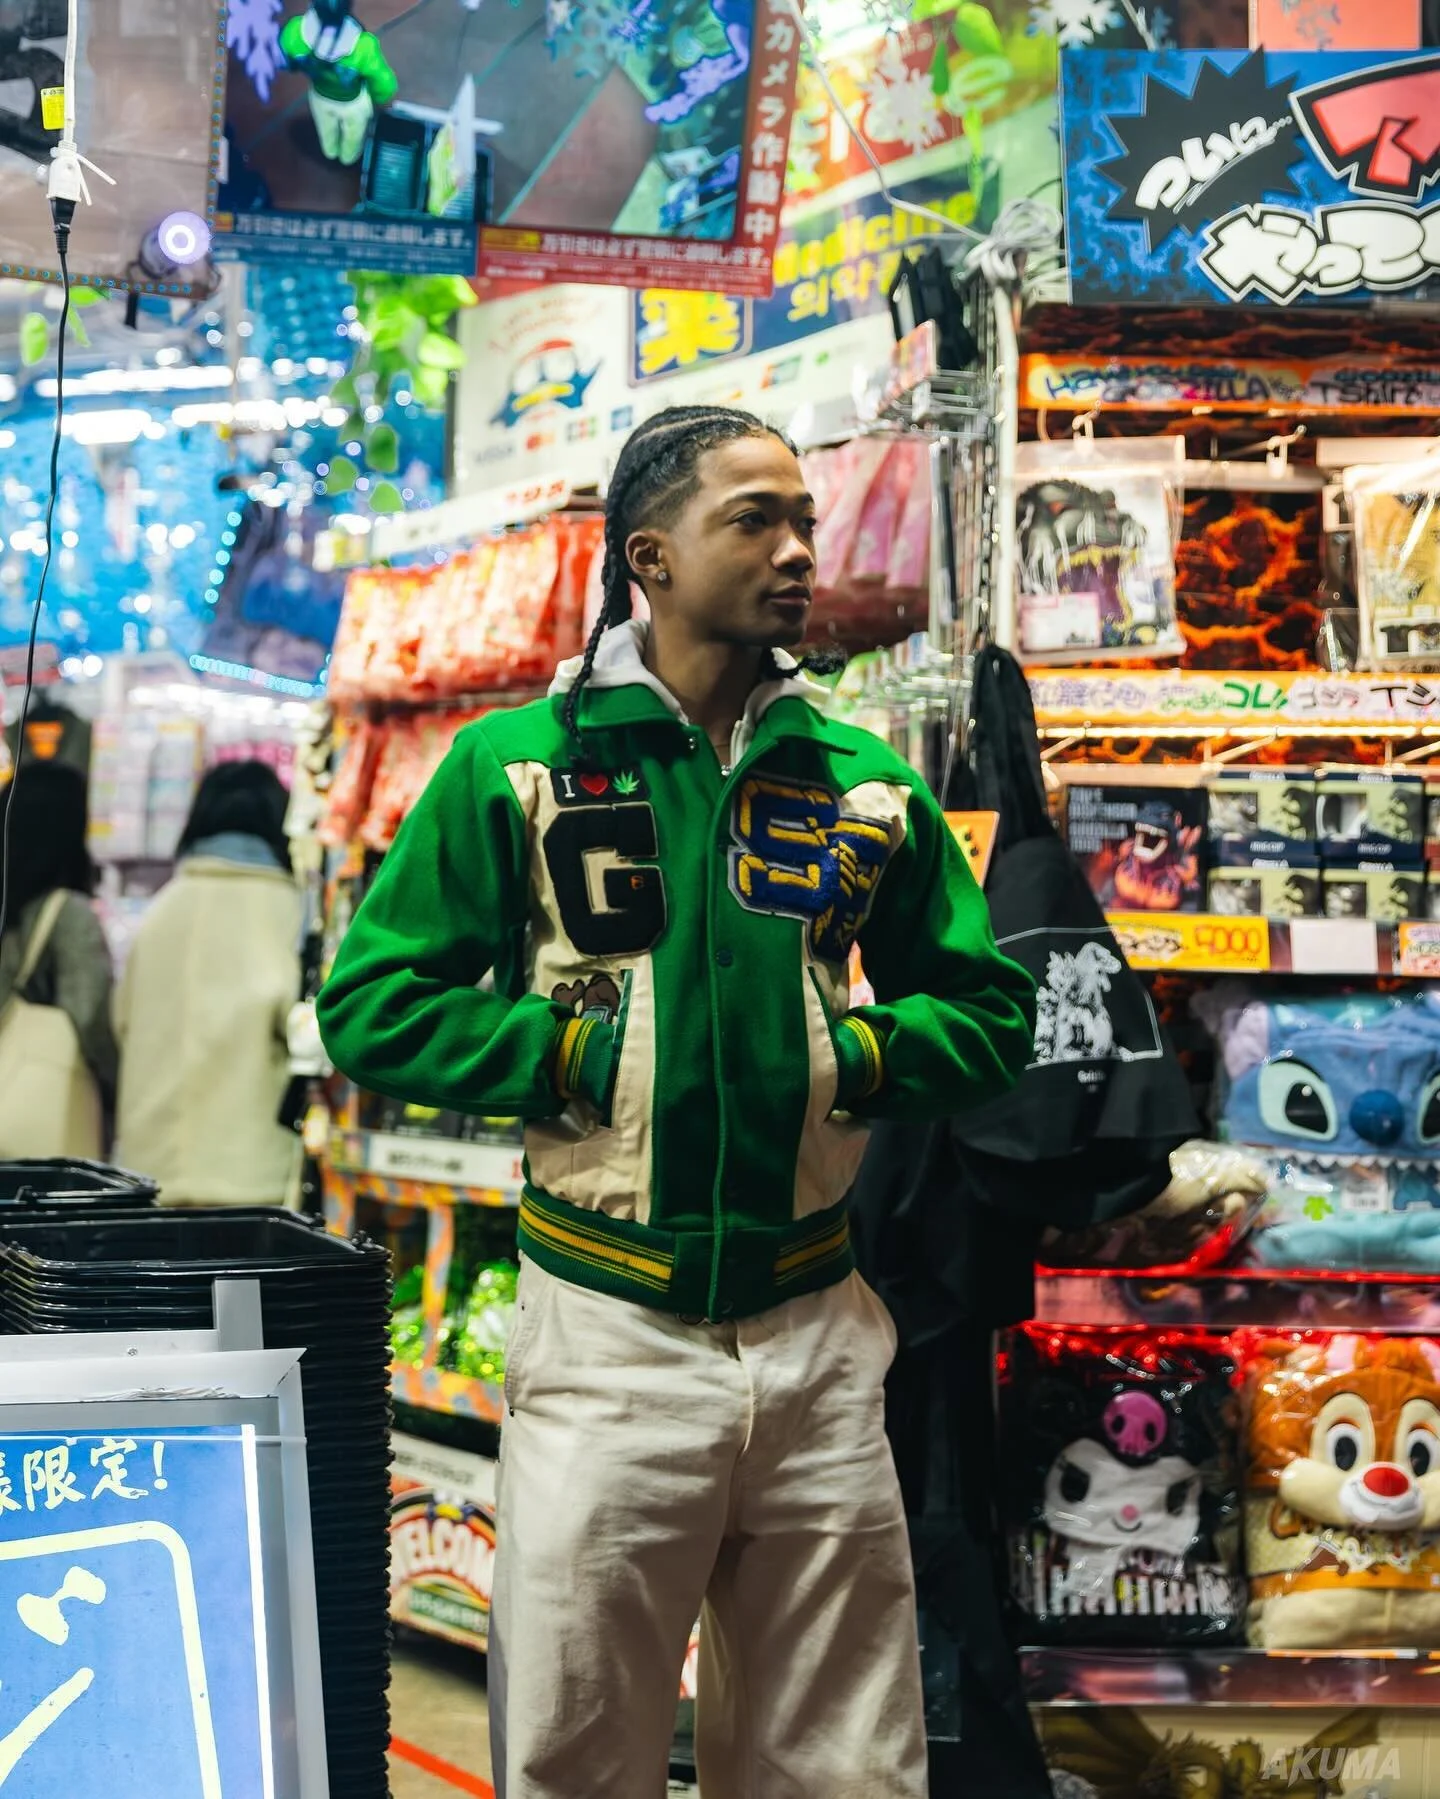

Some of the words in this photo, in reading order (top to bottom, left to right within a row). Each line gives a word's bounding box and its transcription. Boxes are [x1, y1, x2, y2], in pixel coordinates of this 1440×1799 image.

[743, 0, 796, 243] カメラ作動中
[560, 774, 576, 798] I
